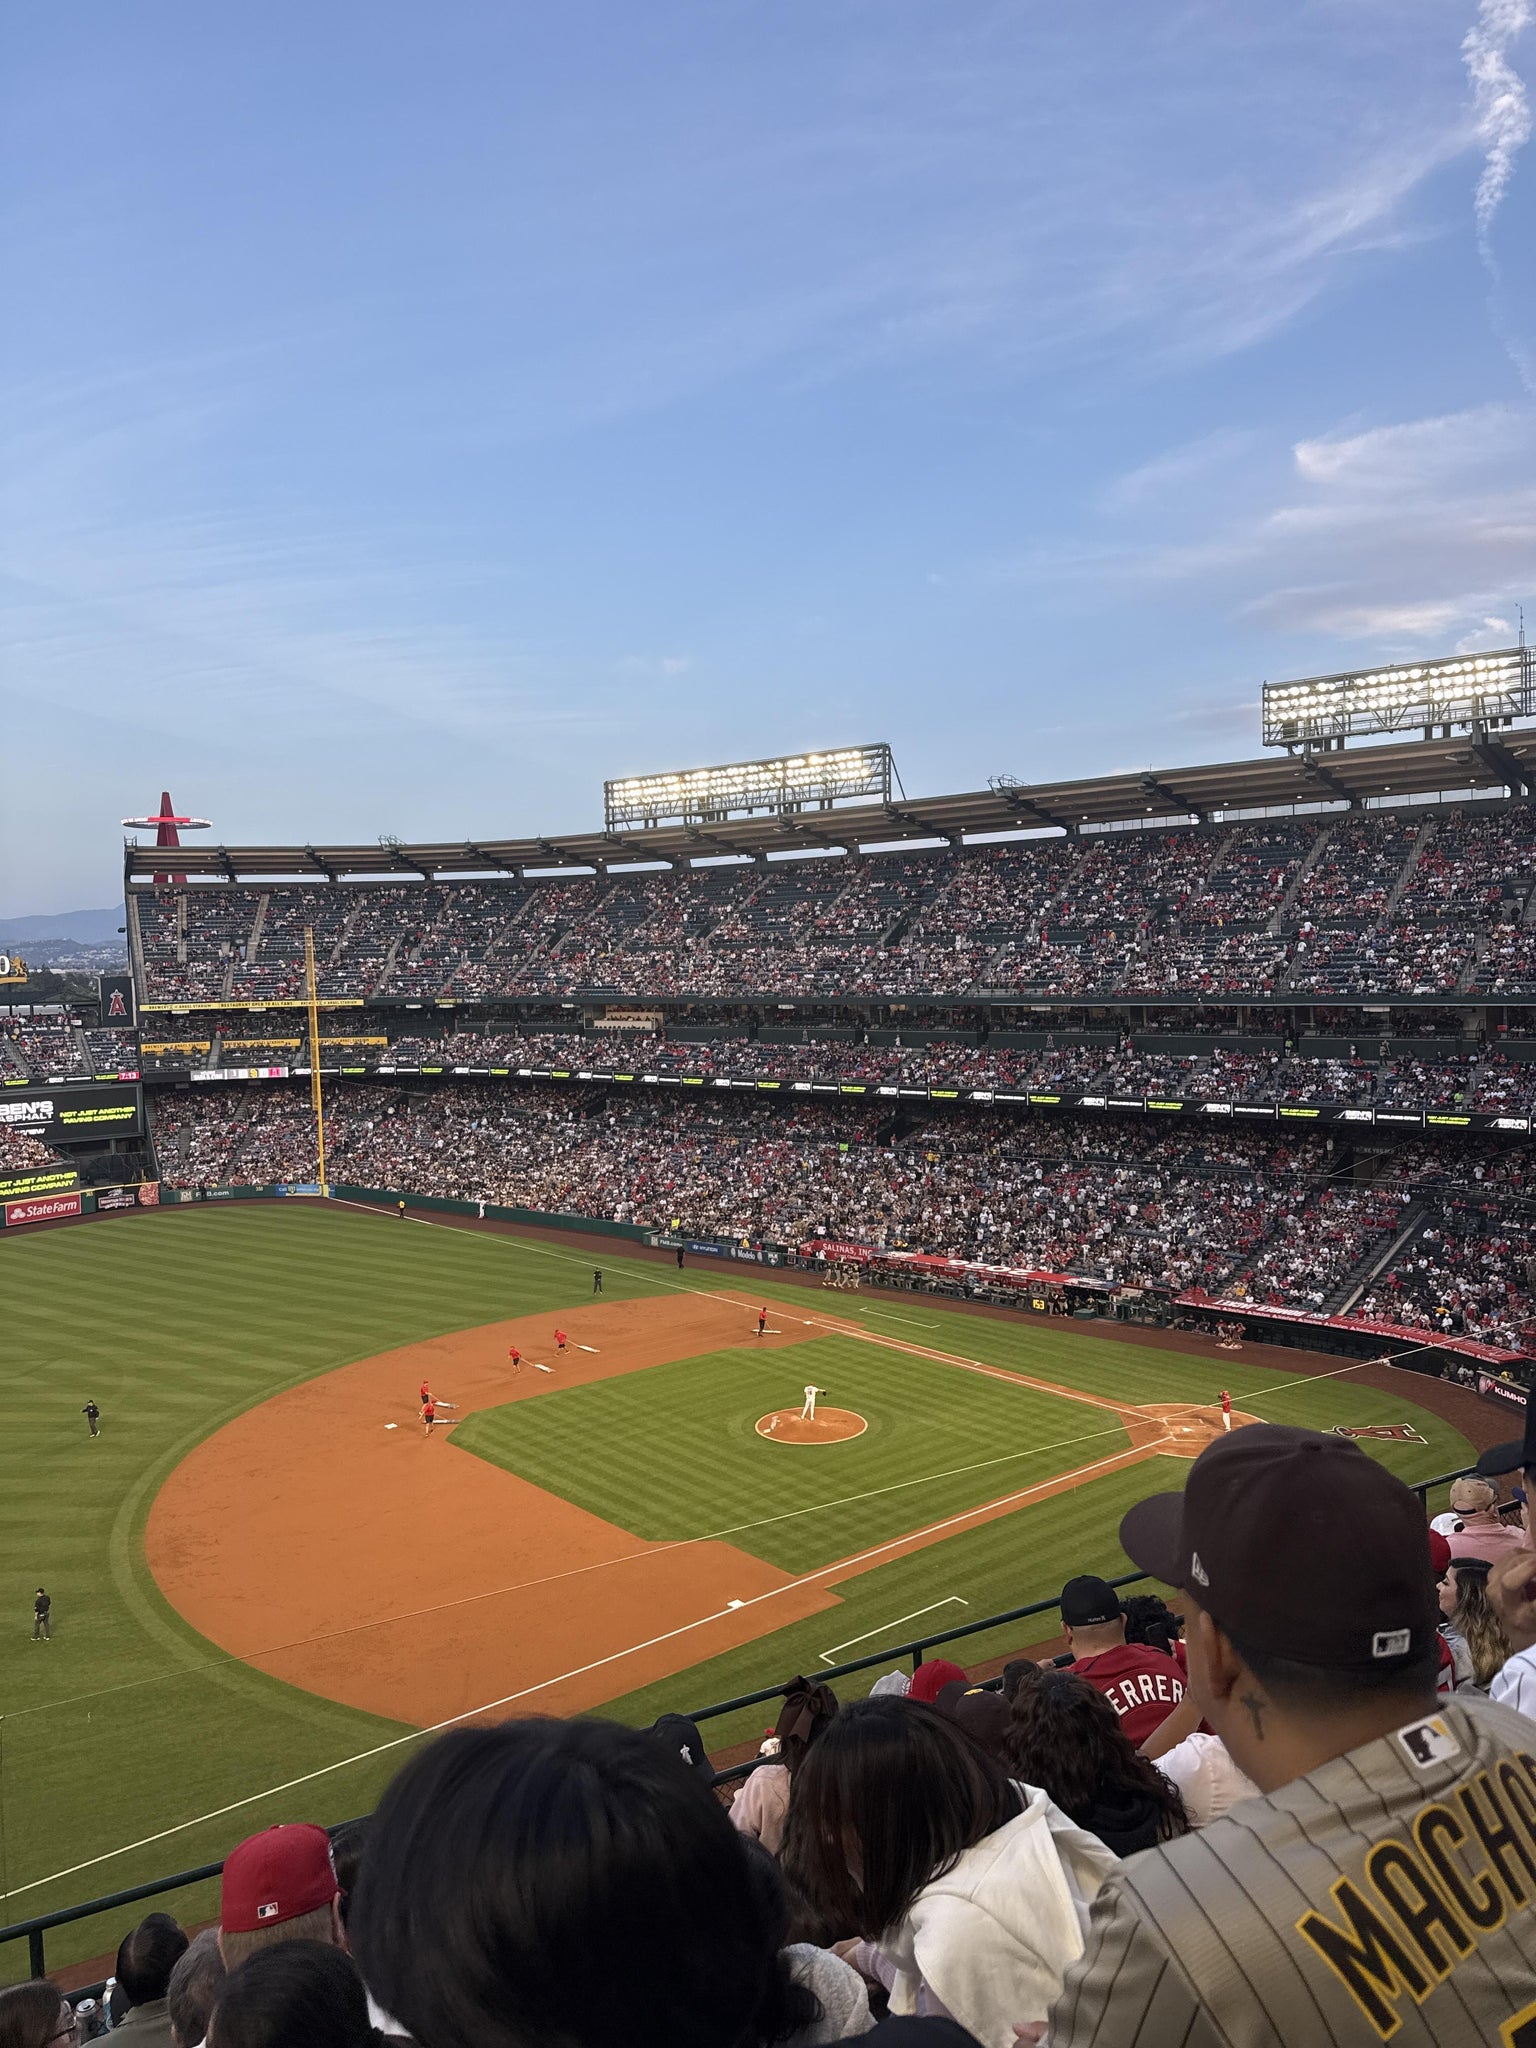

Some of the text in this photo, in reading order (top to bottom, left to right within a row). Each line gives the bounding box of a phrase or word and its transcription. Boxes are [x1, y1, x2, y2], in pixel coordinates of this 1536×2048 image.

[0, 1101, 54, 1116] BEN'S
[98, 1106, 136, 1114] ANOTHER
[0, 1111, 54, 1122] ASPHALT
[63, 1113, 133, 1124] PAVING COMPANY
[0, 1171, 78, 1188] OT JUST ANOTHER
[0, 1180, 74, 1196] PAVING COMPANY
[737, 1249, 756, 1260] Modelo
[822, 1243, 856, 1256] SALINAS,
[1494, 1386, 1527, 1405] KUMHO
[1104, 1674, 1187, 1716] ERRER
[1295, 1751, 1536, 2041] MACHA
